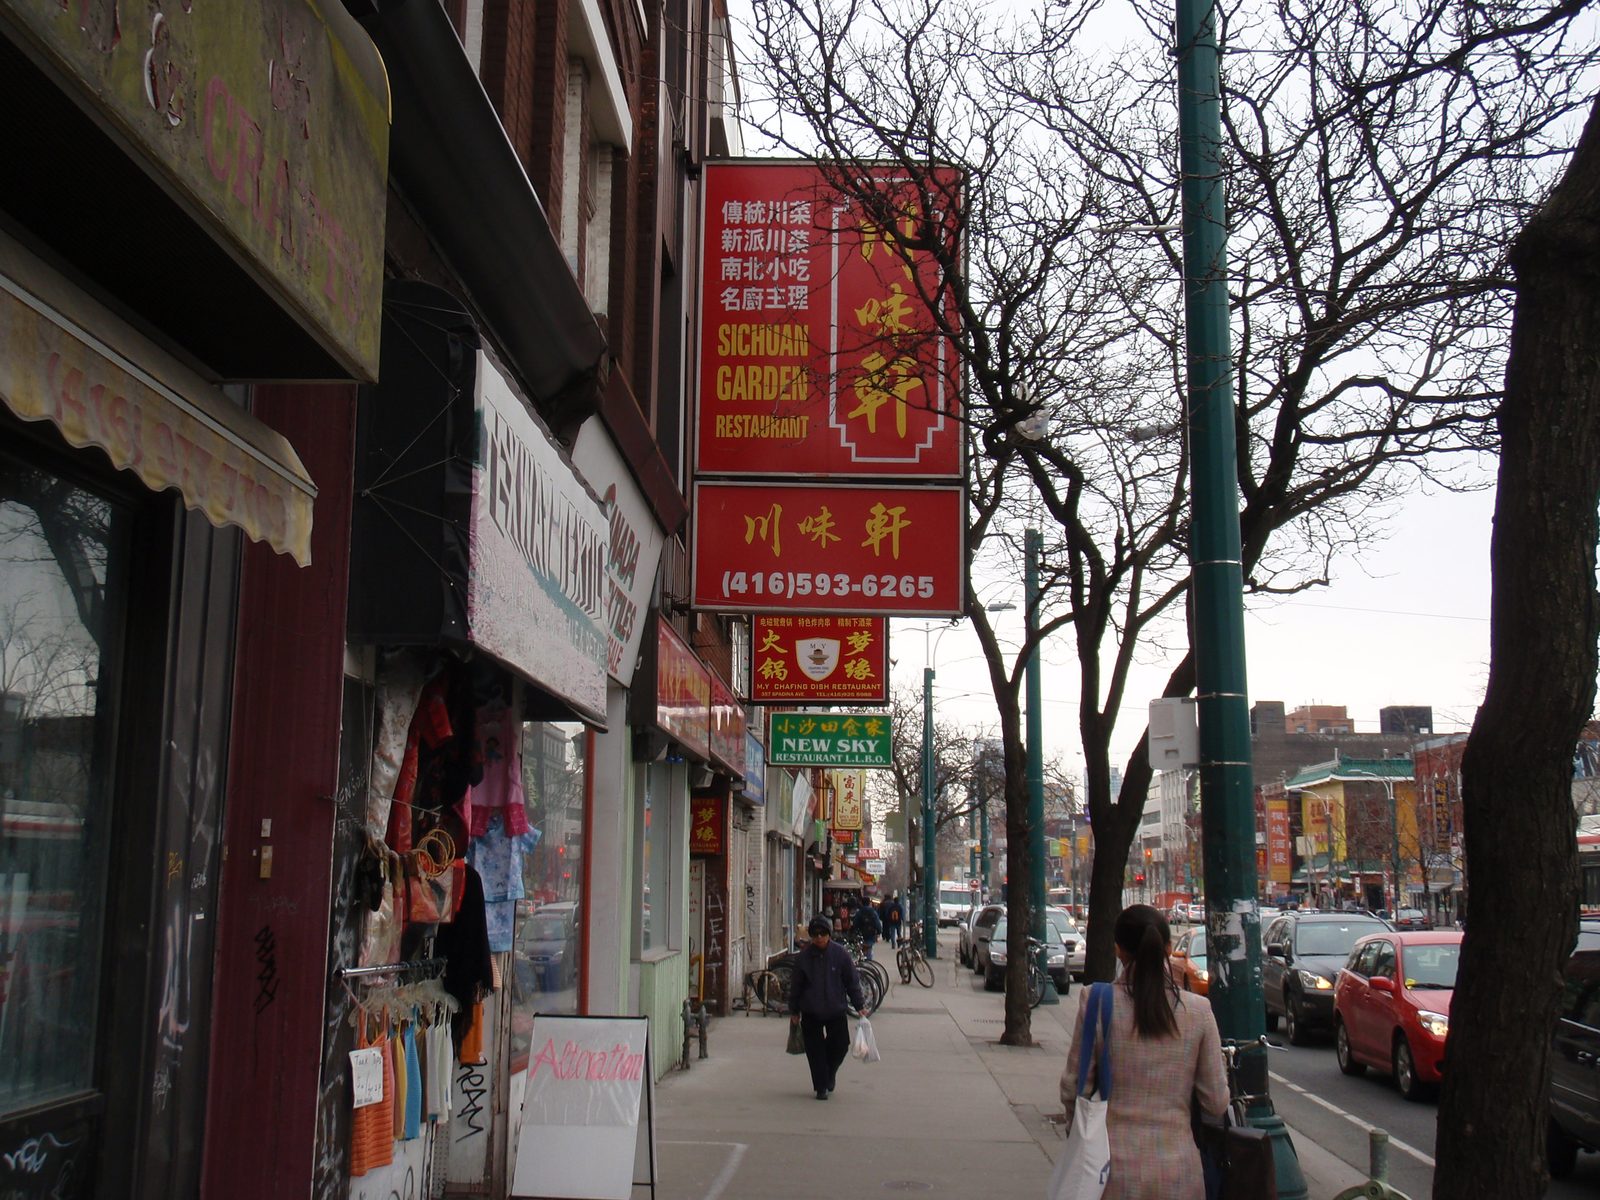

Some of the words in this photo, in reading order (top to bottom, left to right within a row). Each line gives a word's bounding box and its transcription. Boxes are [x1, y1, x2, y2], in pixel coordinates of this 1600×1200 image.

[722, 201, 811, 225] 傳統川菜
[721, 228, 810, 254] 新派川菜
[720, 256, 811, 281] 南北小吃
[720, 285, 809, 311] 名廚主理
[717, 323, 809, 357] SICHUAN
[716, 365, 808, 401] GARDEN
[715, 414, 809, 439] RESTAURANT
[743, 502, 912, 560] 川味軒
[721, 571, 935, 599] (416)593-6265
[757, 629, 788, 682] 火锅
[844, 630, 876, 682] 梦缘
[777, 718, 885, 737] 小沙田食家
[775, 753, 844, 762] RESTAURANT
[845, 754, 886, 763] L.L.B.O.
[782, 738, 832, 752] NEW
[836, 739, 880, 753] SKY
[528, 1037, 645, 1082] Alteration
